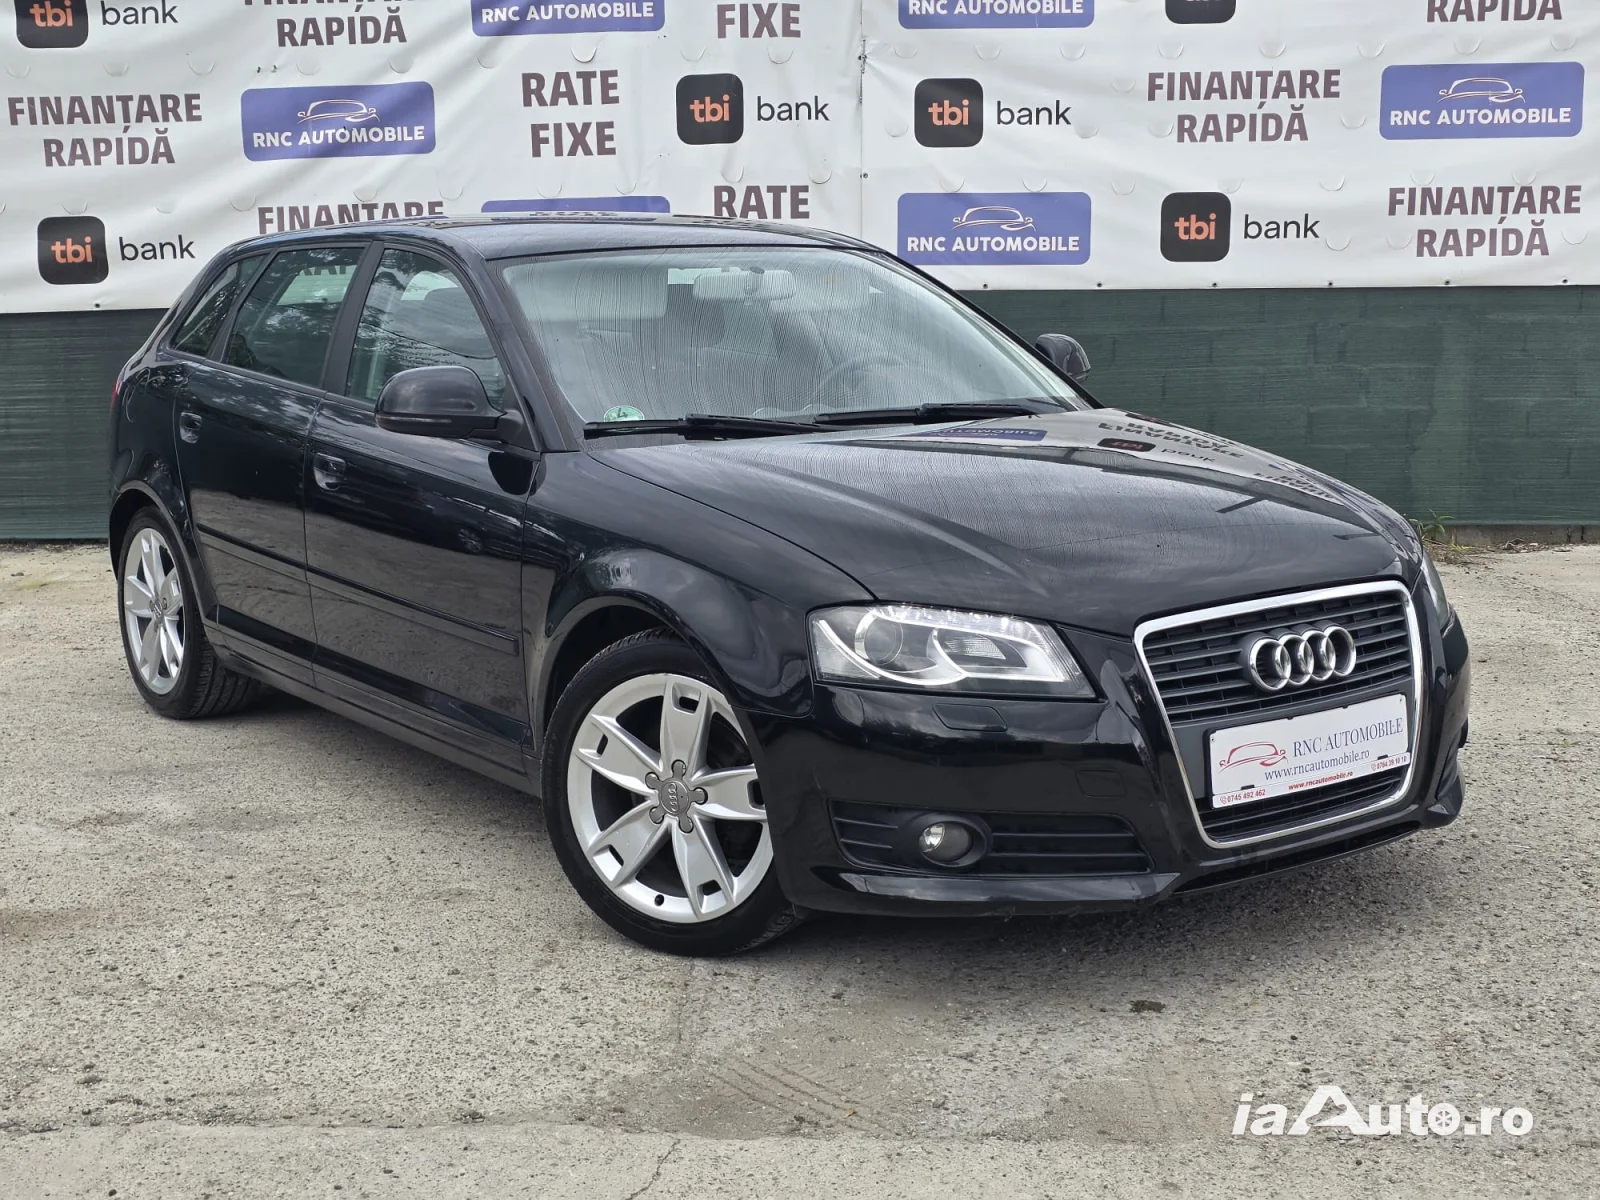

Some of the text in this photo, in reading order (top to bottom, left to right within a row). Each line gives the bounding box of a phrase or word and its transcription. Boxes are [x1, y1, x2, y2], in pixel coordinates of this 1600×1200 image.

[30, 0, 179, 27] tbi bank
[481, 2, 654, 24] RNC AUTOMOBILE
[716, 3, 801, 39] FIXE
[908, 0, 1084, 15] RNC AUTOMOBILE
[521, 69, 620, 107] RATE
[689, 94, 830, 123] tbi bank
[927, 99, 1071, 126] tbi bank
[1390, 107, 1571, 126] RNC AUTOMOBILE
[253, 126, 425, 148] RNC AUTOMOBILE
[531, 121, 616, 157] FIXE
[713, 184, 810, 220] RATE
[1174, 212, 1320, 241] tbi bank
[51, 235, 195, 264] tbi bank
[907, 236, 1079, 252] RNC AUTOMOBILE
[1293, 717, 1404, 757] RNC AUTOMOBILE
[1264, 749, 1370, 781] www.rncautomobile.ro
[1288, 770, 1354, 791] www.rncautomobile.ro
[1226, 788, 1266, 803] 0745 492 462
